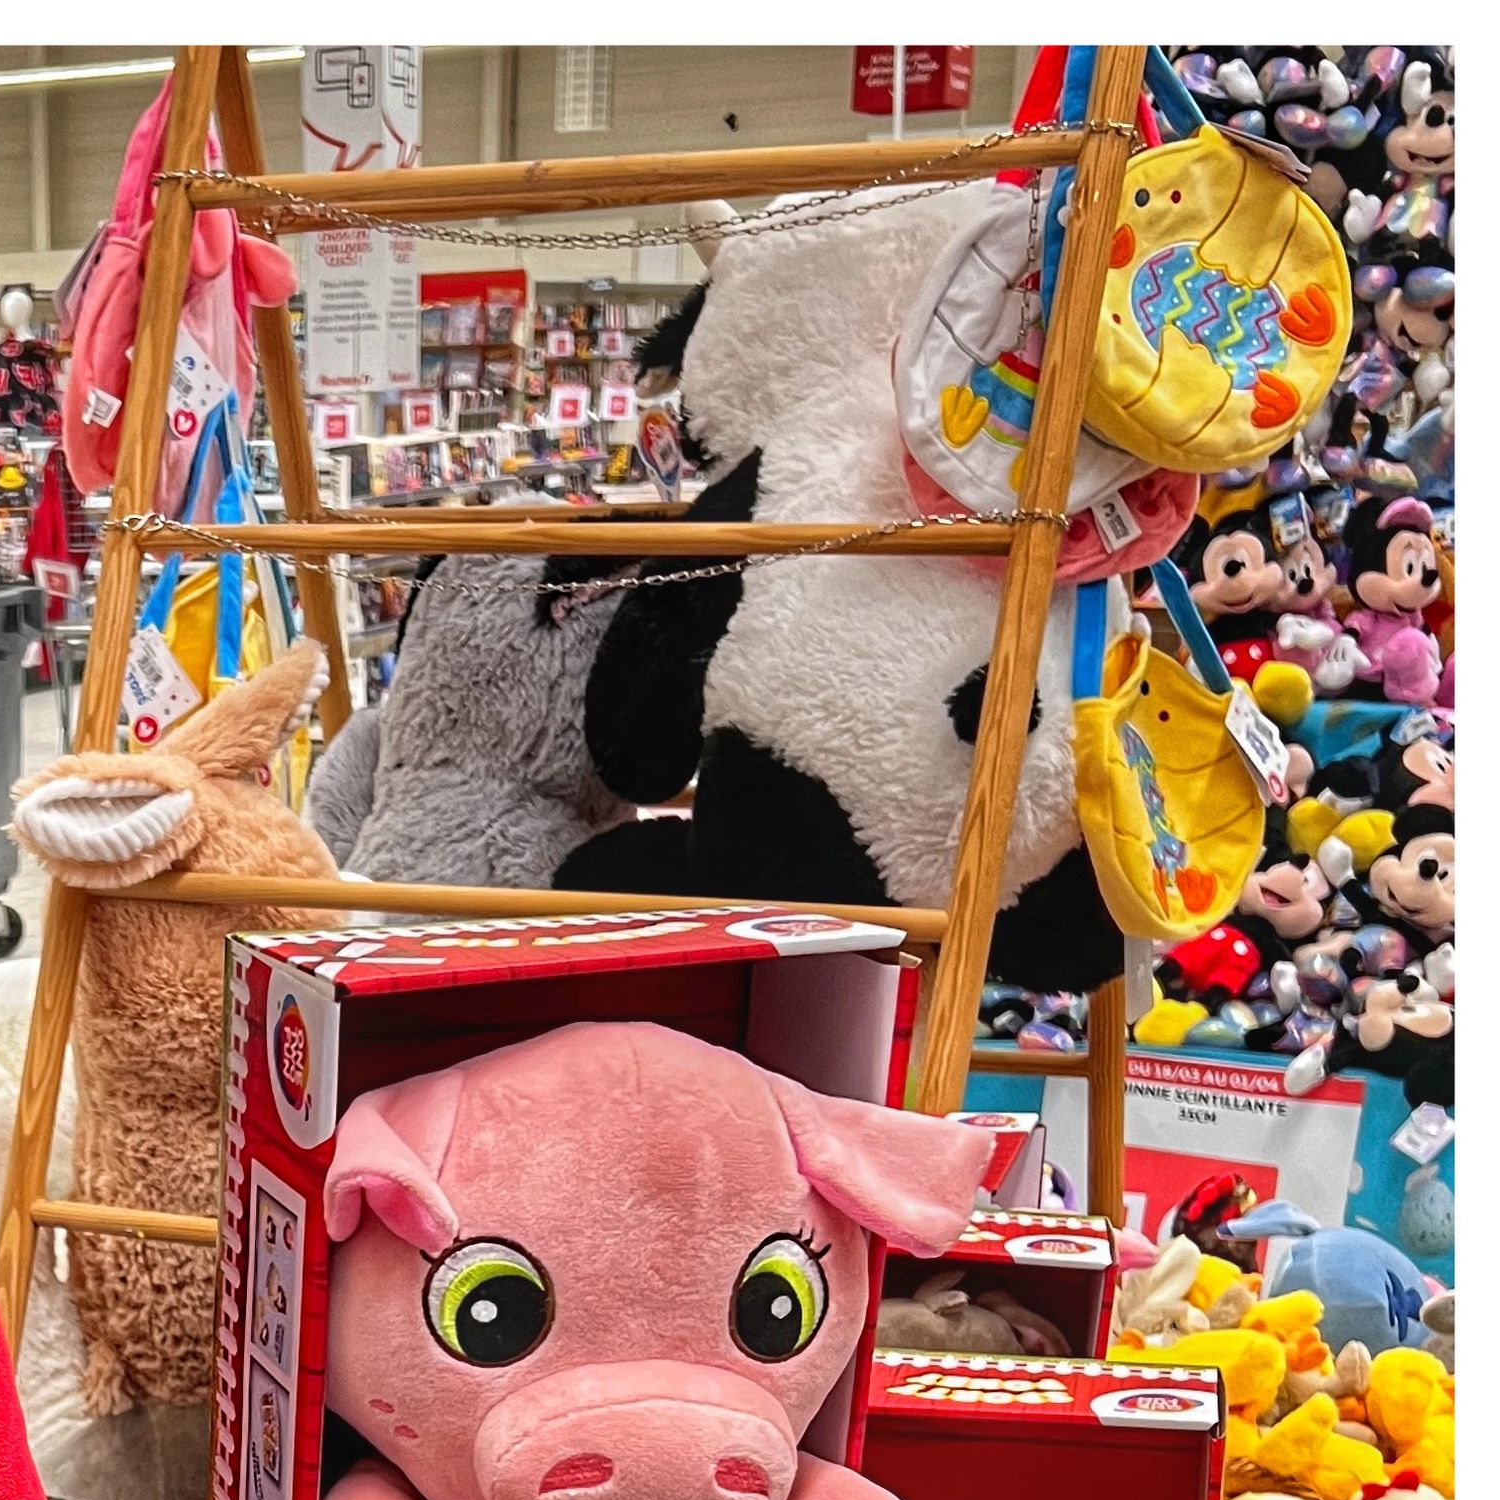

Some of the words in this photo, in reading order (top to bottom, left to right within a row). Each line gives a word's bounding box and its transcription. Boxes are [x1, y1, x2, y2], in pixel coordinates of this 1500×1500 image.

[1128, 1060, 1151, 1076] DU
[1203, 1069, 1228, 1086] AU
[1175, 1088, 1288, 1117] SCINTILLANTE
